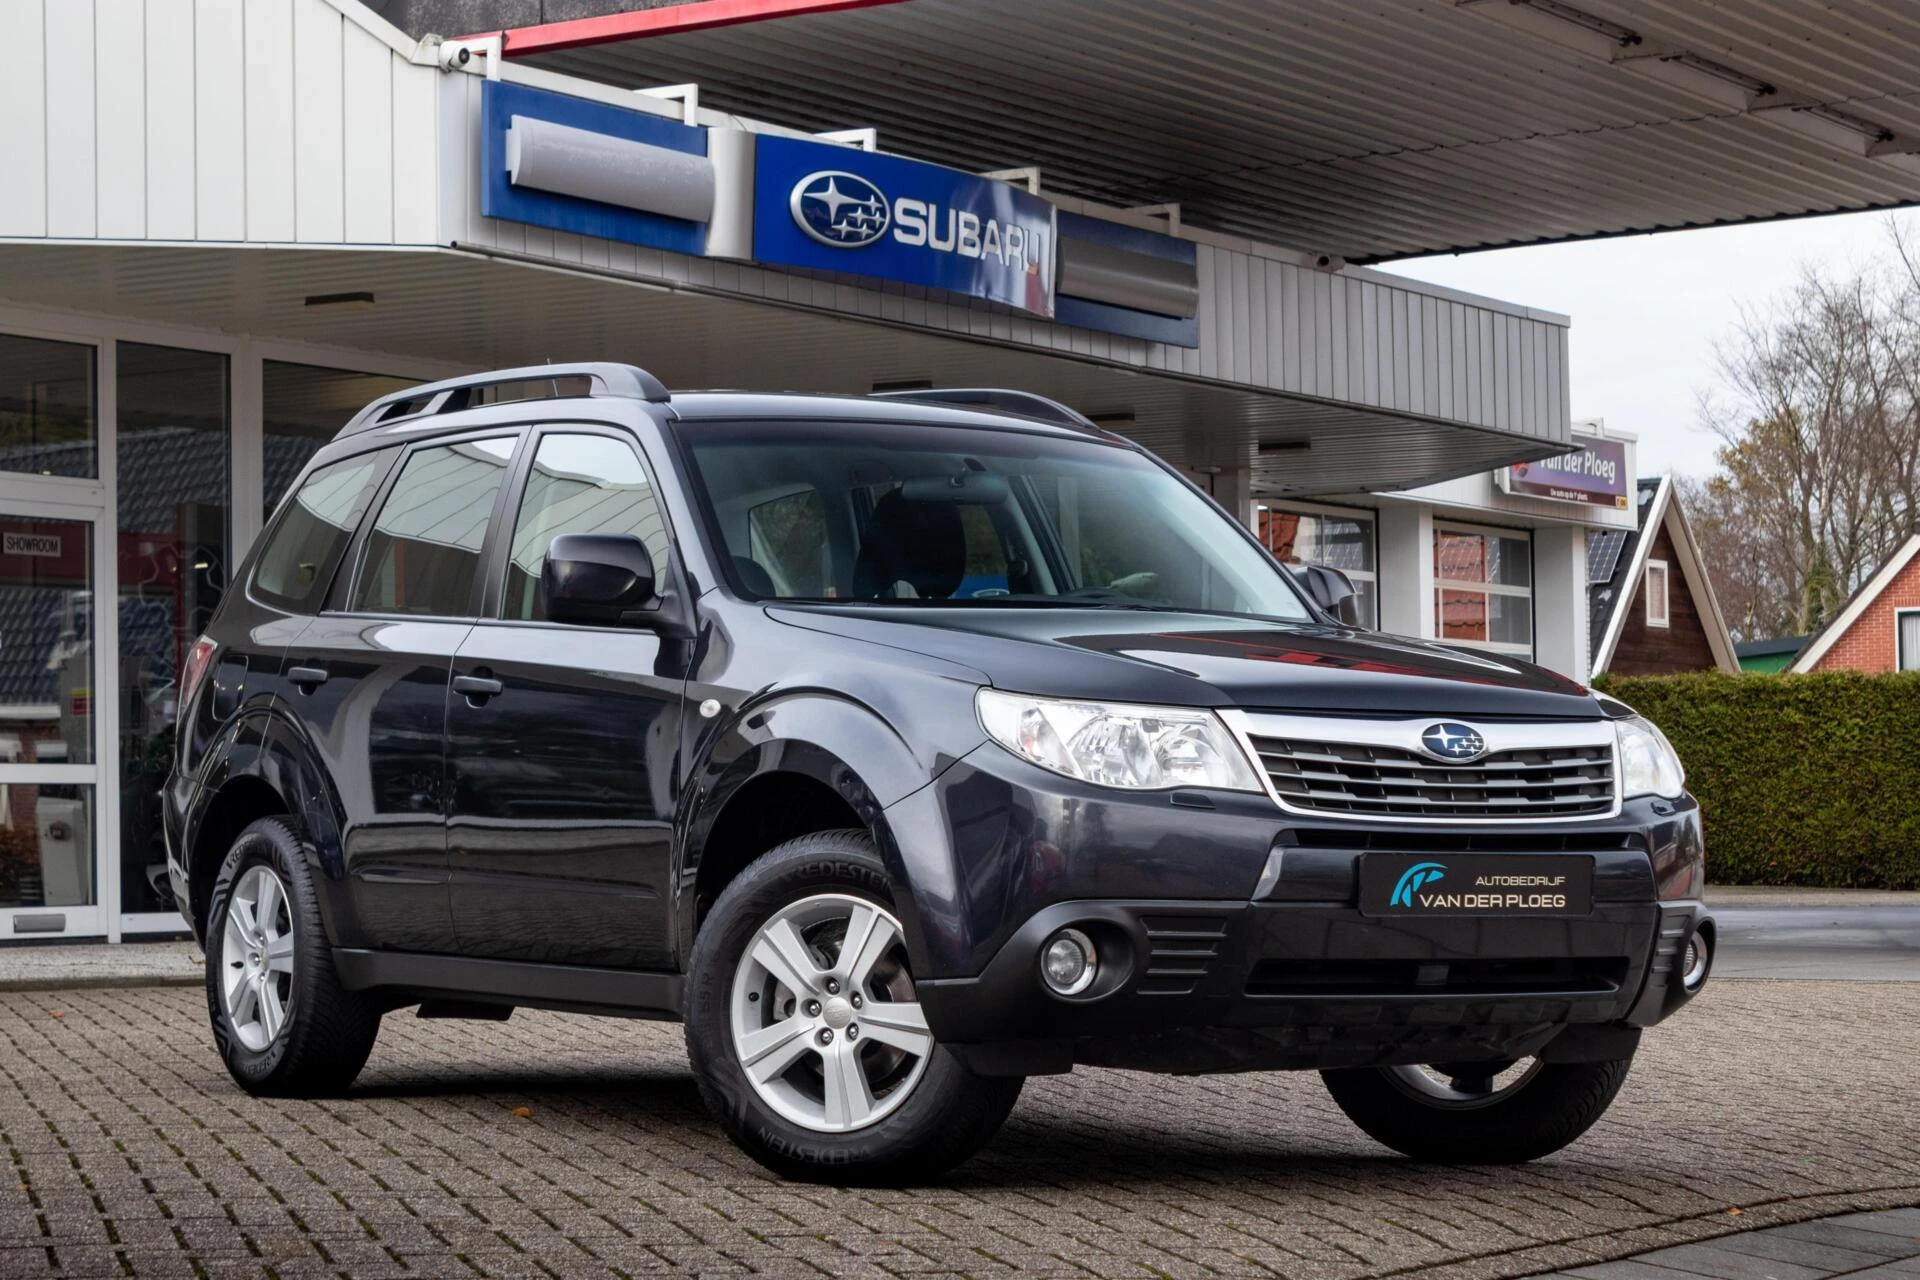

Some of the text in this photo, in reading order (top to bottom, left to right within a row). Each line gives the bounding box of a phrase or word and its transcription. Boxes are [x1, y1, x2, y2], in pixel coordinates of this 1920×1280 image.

[893, 197, 1041, 276] SUBARU
[1564, 451, 1582, 474] der
[1584, 451, 1616, 485] Ploeg
[6, 535, 58, 553] SHOWROOM
[1474, 875, 1567, 887] AUTOBEDRIJF
[1419, 894, 1567, 908] VAN DER PLOEG
